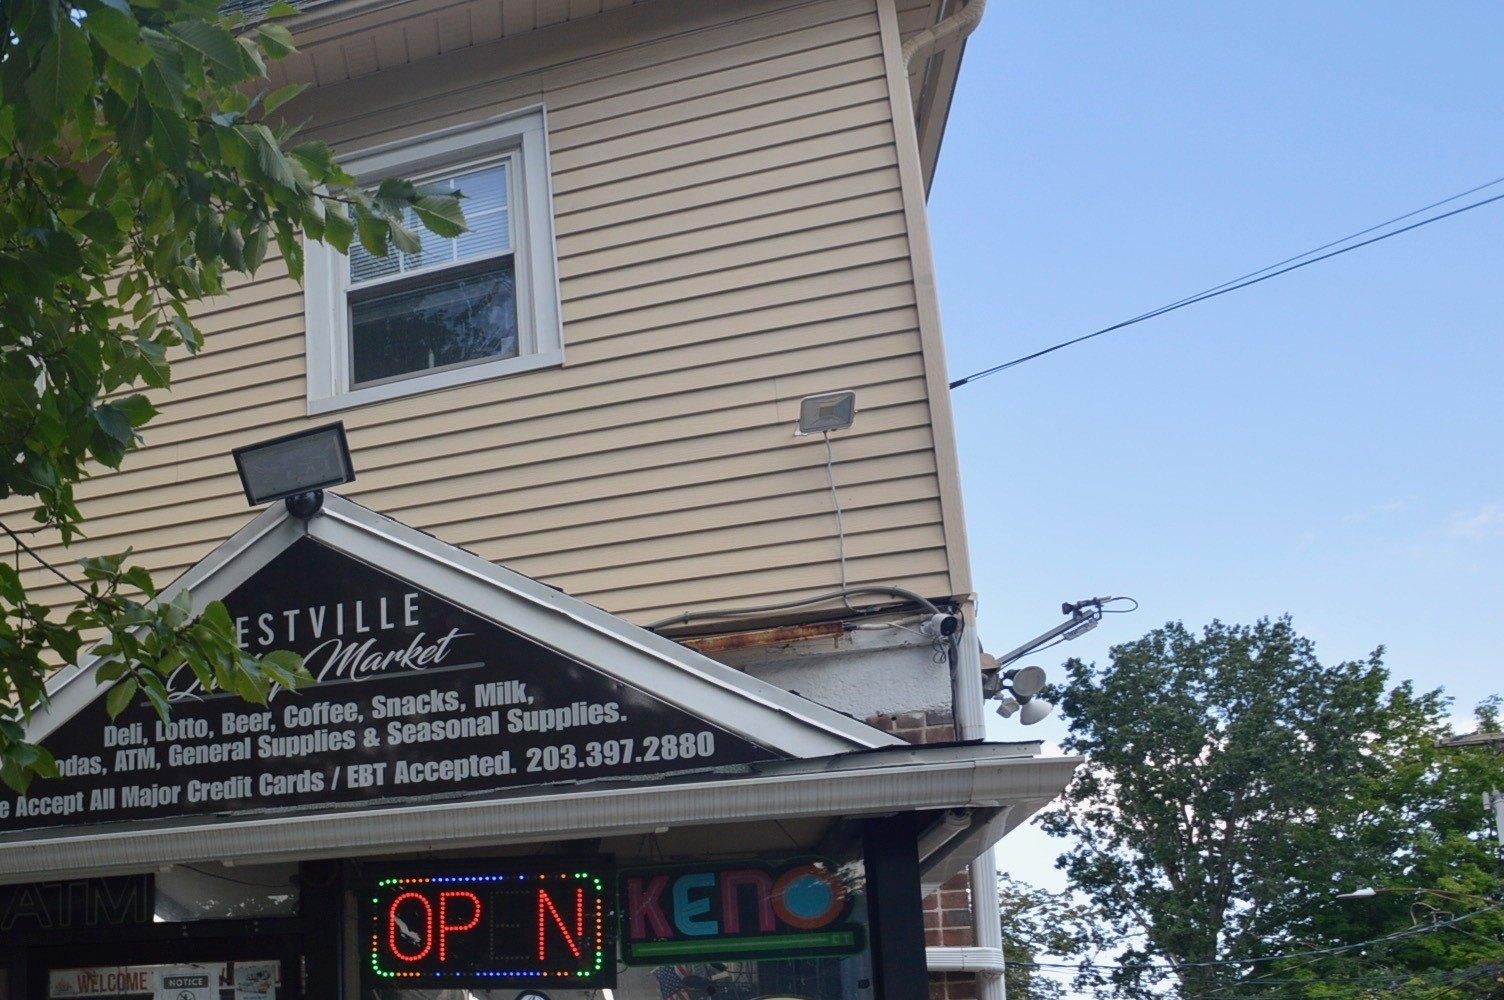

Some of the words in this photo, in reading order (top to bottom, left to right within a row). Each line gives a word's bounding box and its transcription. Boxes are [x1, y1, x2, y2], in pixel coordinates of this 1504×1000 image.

[236, 592, 419, 648] ESTVILLE
[302, 627, 477, 683] Market
[54, 754, 108, 778] odas,
[115, 747, 161, 773] ATM,
[168, 737, 251, 767] General
[258, 727, 355, 759] Supplies
[363, 727, 380, 748] &
[387, 711, 500, 746] Seasonal
[507, 701, 627, 734] Supplies.
[104, 722, 148, 747] Deli,
[155, 717, 215, 743] Lotto,
[222, 711, 276, 735] Beer,
[284, 701, 364, 729] Coffee,
[372, 690, 466, 719] Snacks,
[474, 680, 534, 707] Milk,
[15, 791, 85, 817] Accept
[90, 788, 115, 810] All
[122, 783, 182, 808] Major
[187, 776, 253, 803] Credit
[259, 769, 325, 796] Cards
[347, 762, 387, 788] EBT
[394, 751, 517, 784] Accepted.
[526, 731, 715, 772] 203.397.2880
[0, 876, 148, 930] ATM
[627, 864, 847, 939] KENO
[77, 972, 147, 994] WELCOME
[168, 977, 204, 987] NOTICE
